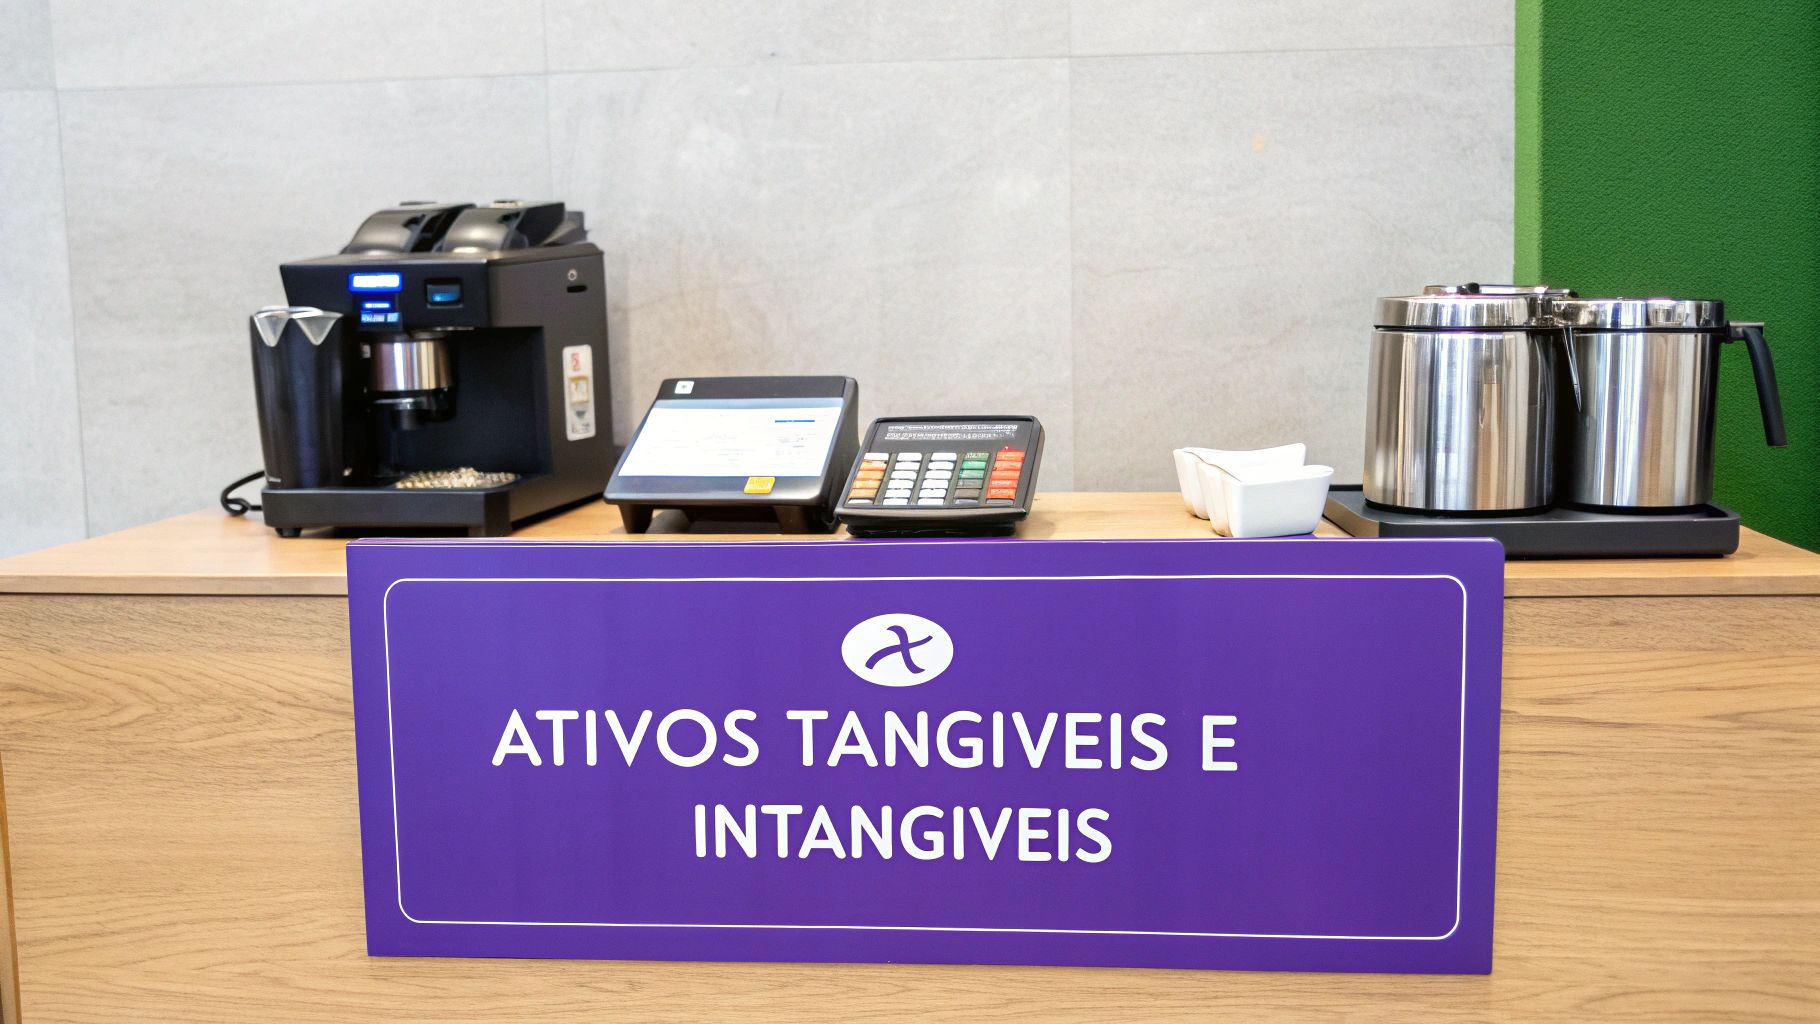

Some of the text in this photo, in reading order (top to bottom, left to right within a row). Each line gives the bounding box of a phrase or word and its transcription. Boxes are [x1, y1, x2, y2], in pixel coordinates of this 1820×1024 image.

[491, 708, 1238, 772] ATIVOS TANGIVEIS E
[694, 803, 1113, 864] INTANGIVEIS
